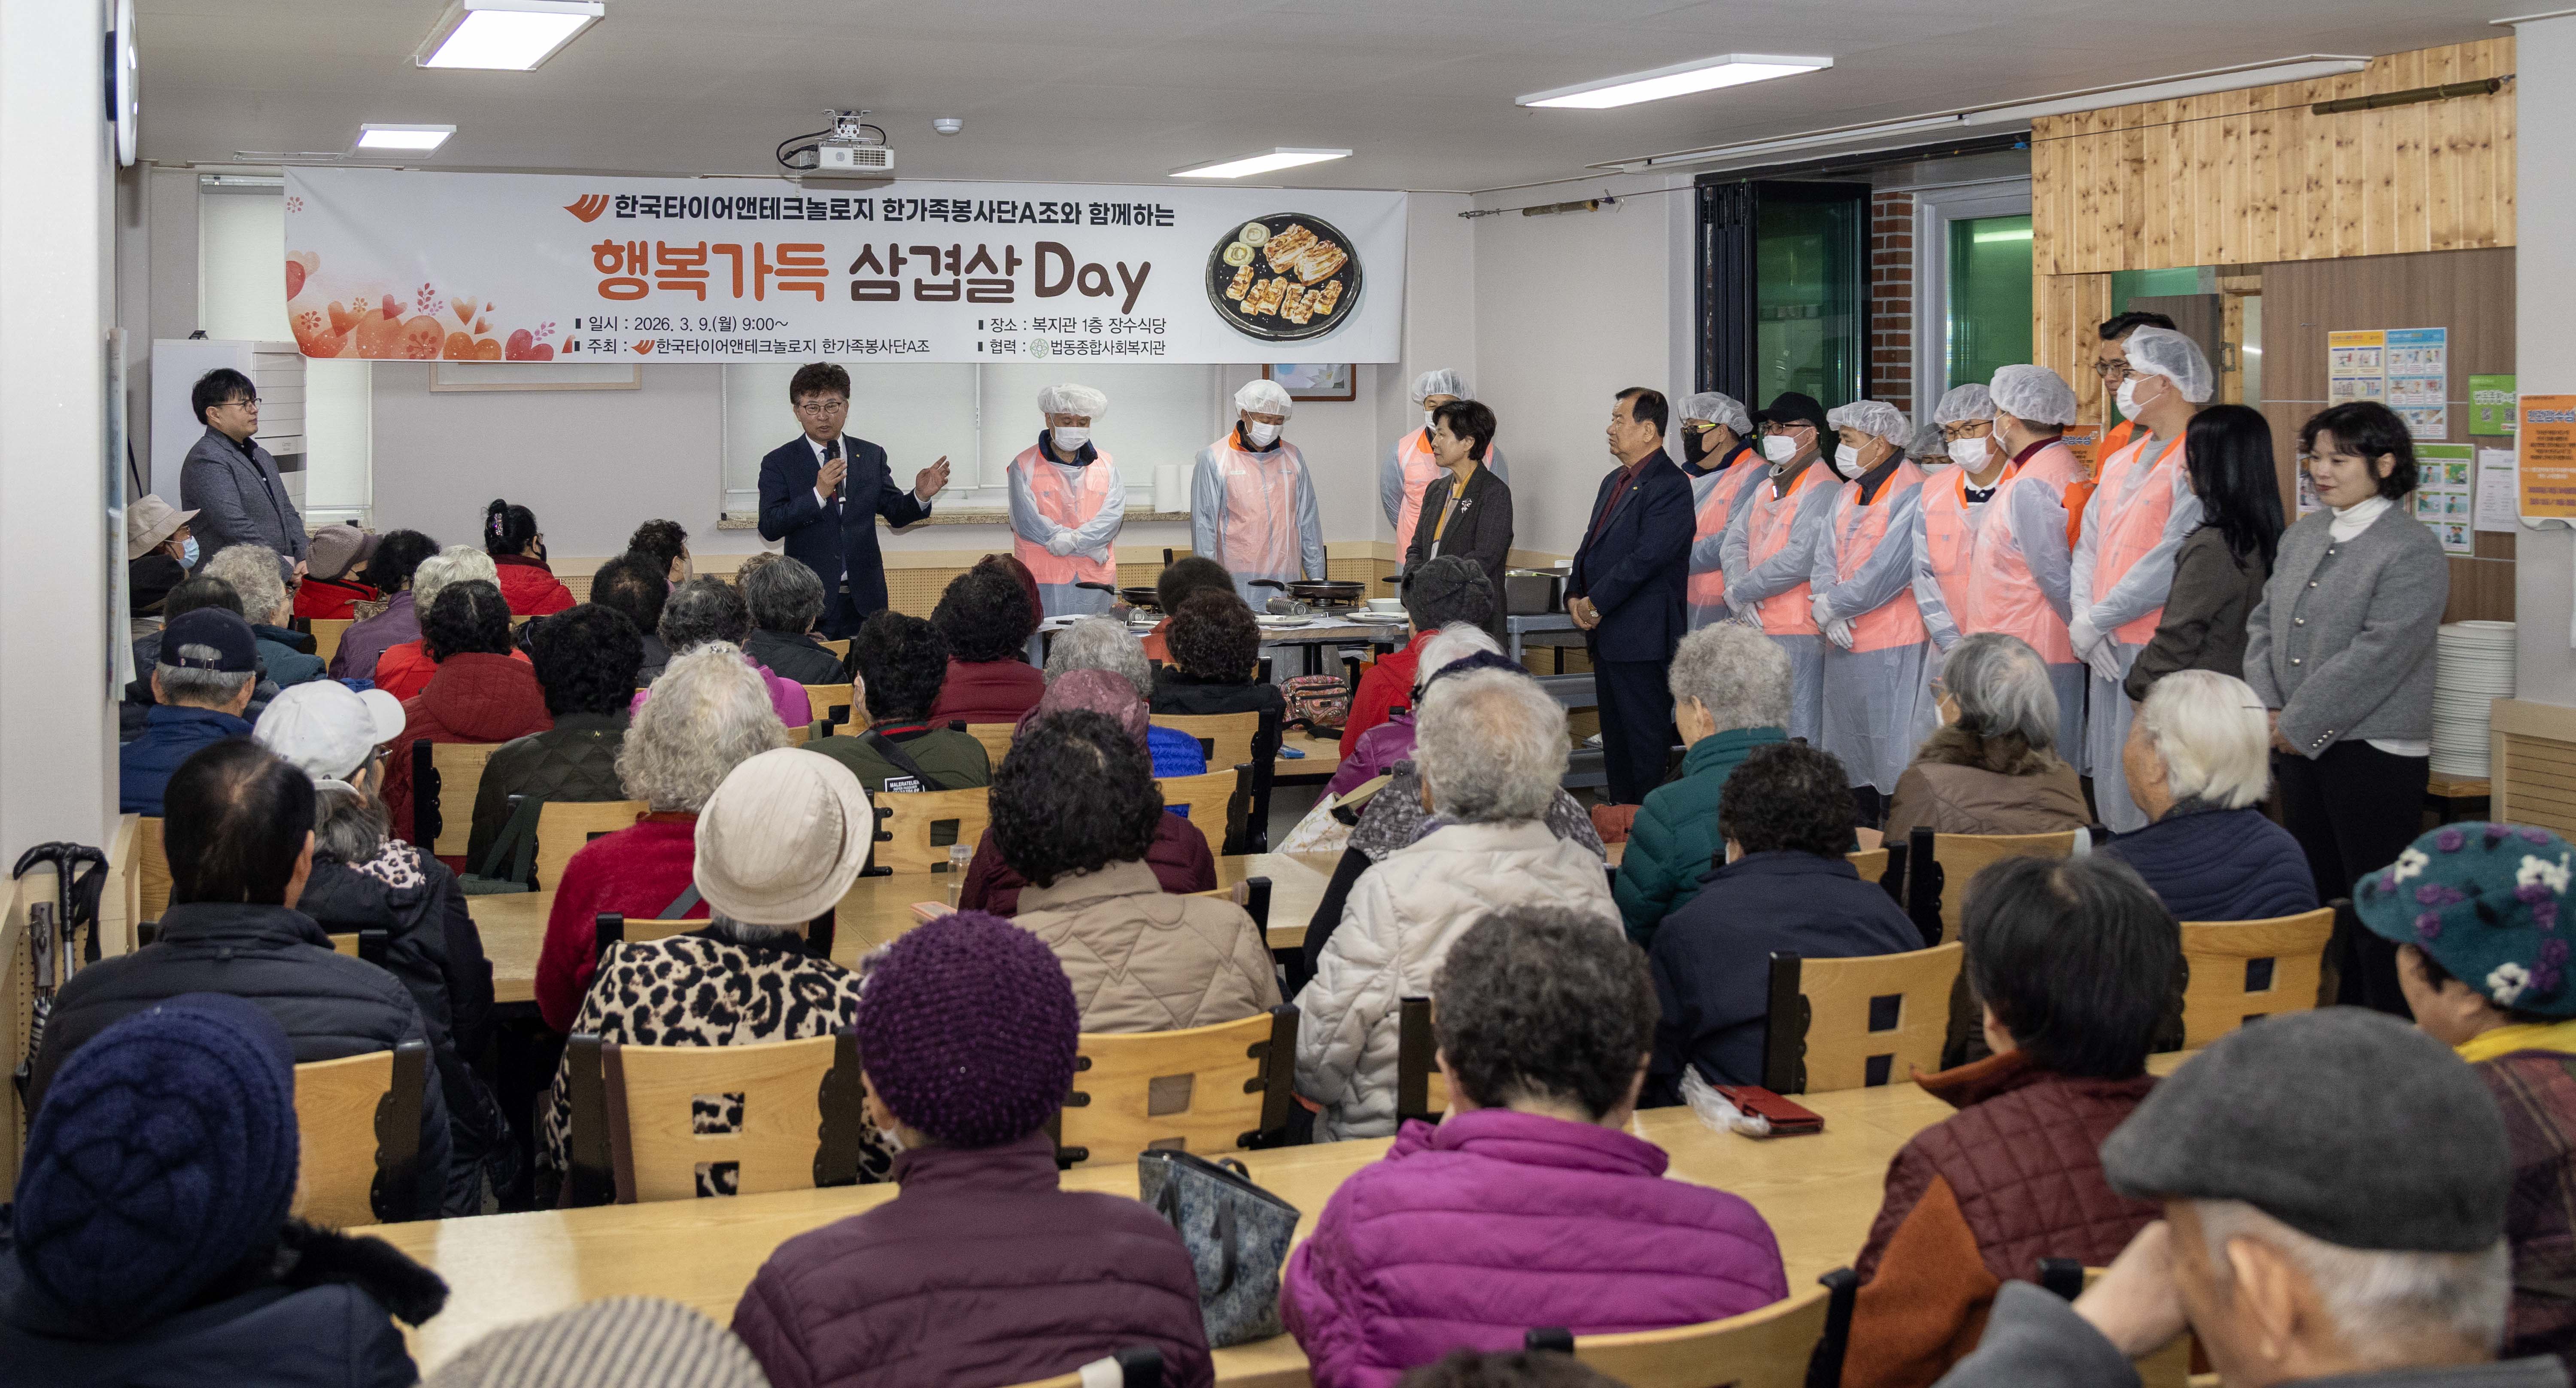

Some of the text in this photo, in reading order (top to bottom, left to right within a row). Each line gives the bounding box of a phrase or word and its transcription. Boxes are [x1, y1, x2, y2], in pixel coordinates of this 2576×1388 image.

[615, 195, 1175, 227] 한국타이어앤테크놀로지 한가족봉사단A조와 함께하는
[592, 239, 1151, 315] 행복가득 삼겹살 Day
[589, 316, 618, 332] 일시
[635, 317, 674, 332] 2026.
[680, 318, 693, 332] 3.
[699, 316, 737, 333] 9.(월)
[991, 318, 1018, 333] 장소
[1033, 317, 1078, 334] 복지관
[1082, 317, 1103, 334] 1층
[1109, 317, 1167, 335] 장수식당
[587, 339, 617, 355] 주최
[656, 339, 816, 355] 한국타이어앤테크놀로지
[823, 338, 931, 355] 한가족봉사단A조
[990, 339, 1017, 355] 협력
[1051, 340, 1166, 356] 법동종합사회복지관
